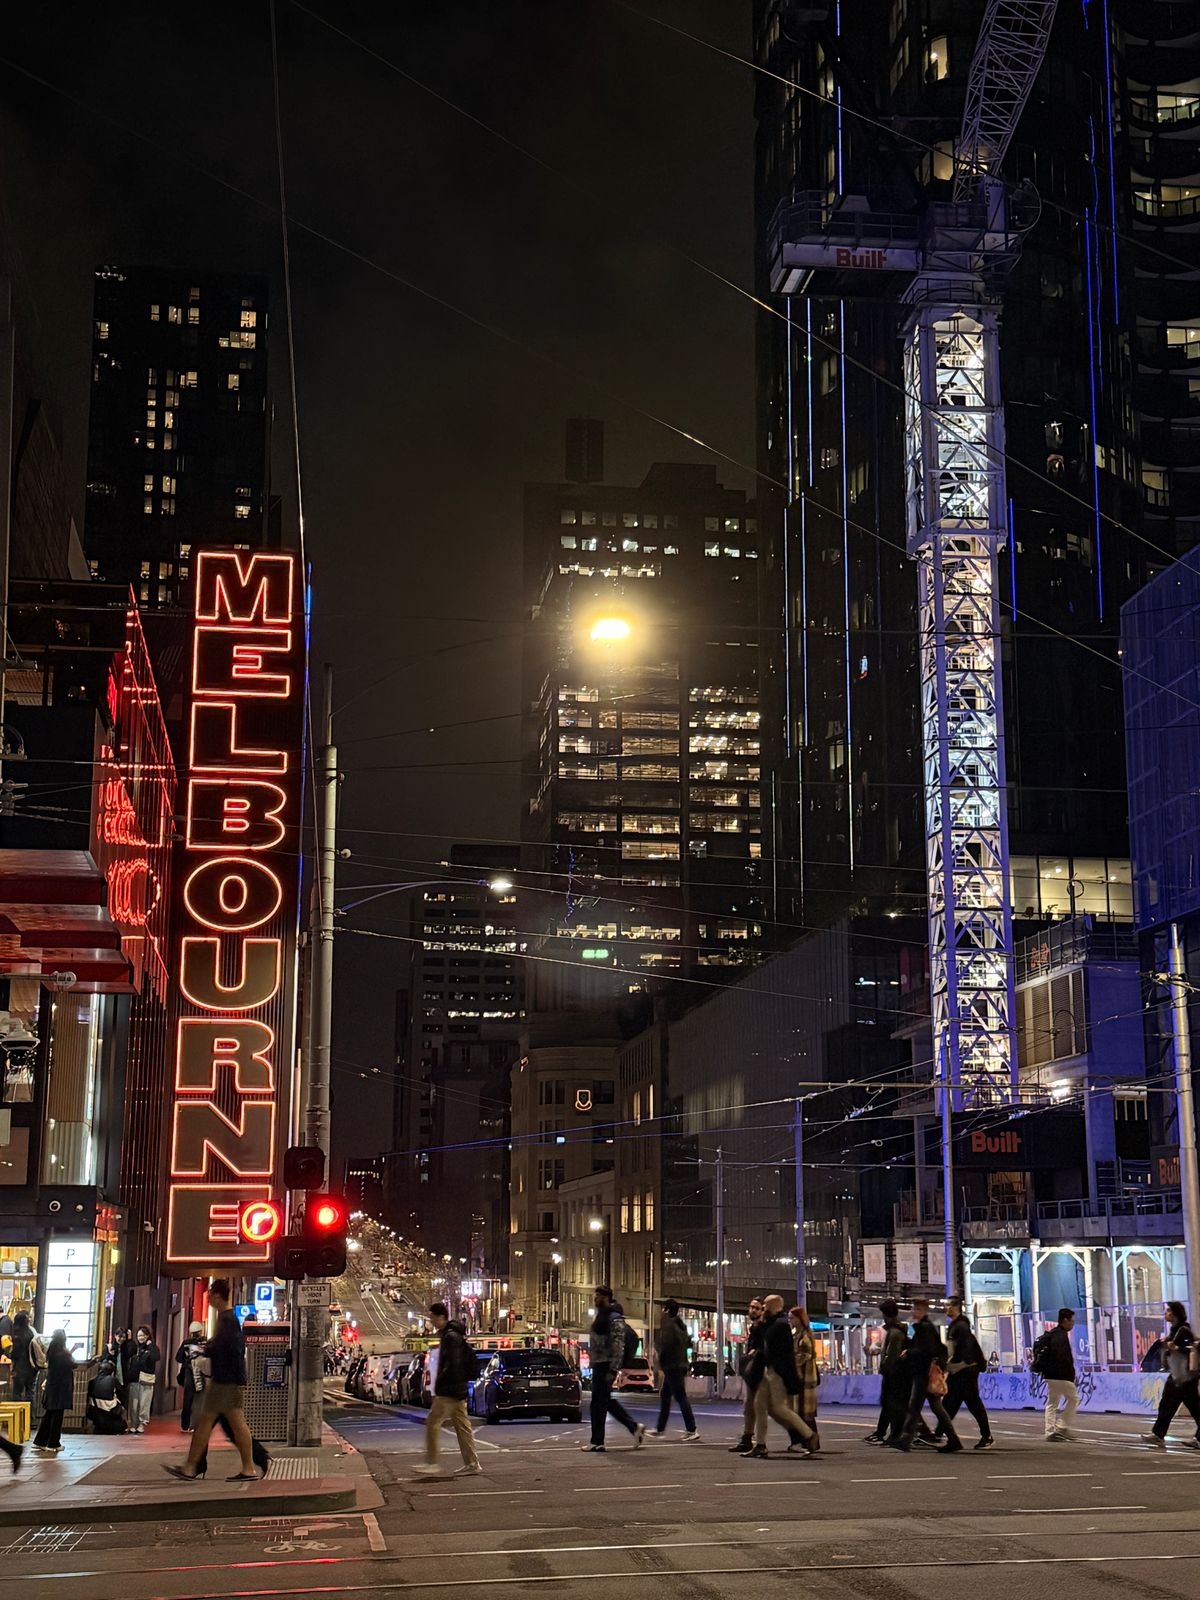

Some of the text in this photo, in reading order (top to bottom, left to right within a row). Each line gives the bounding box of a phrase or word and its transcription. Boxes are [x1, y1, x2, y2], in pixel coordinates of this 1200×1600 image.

[837, 248, 887, 268] Built
[166, 551, 294, 1262] MELBOURNE
[971, 1130, 1022, 1153] Built
[1159, 1156, 1179, 1185] Buil
